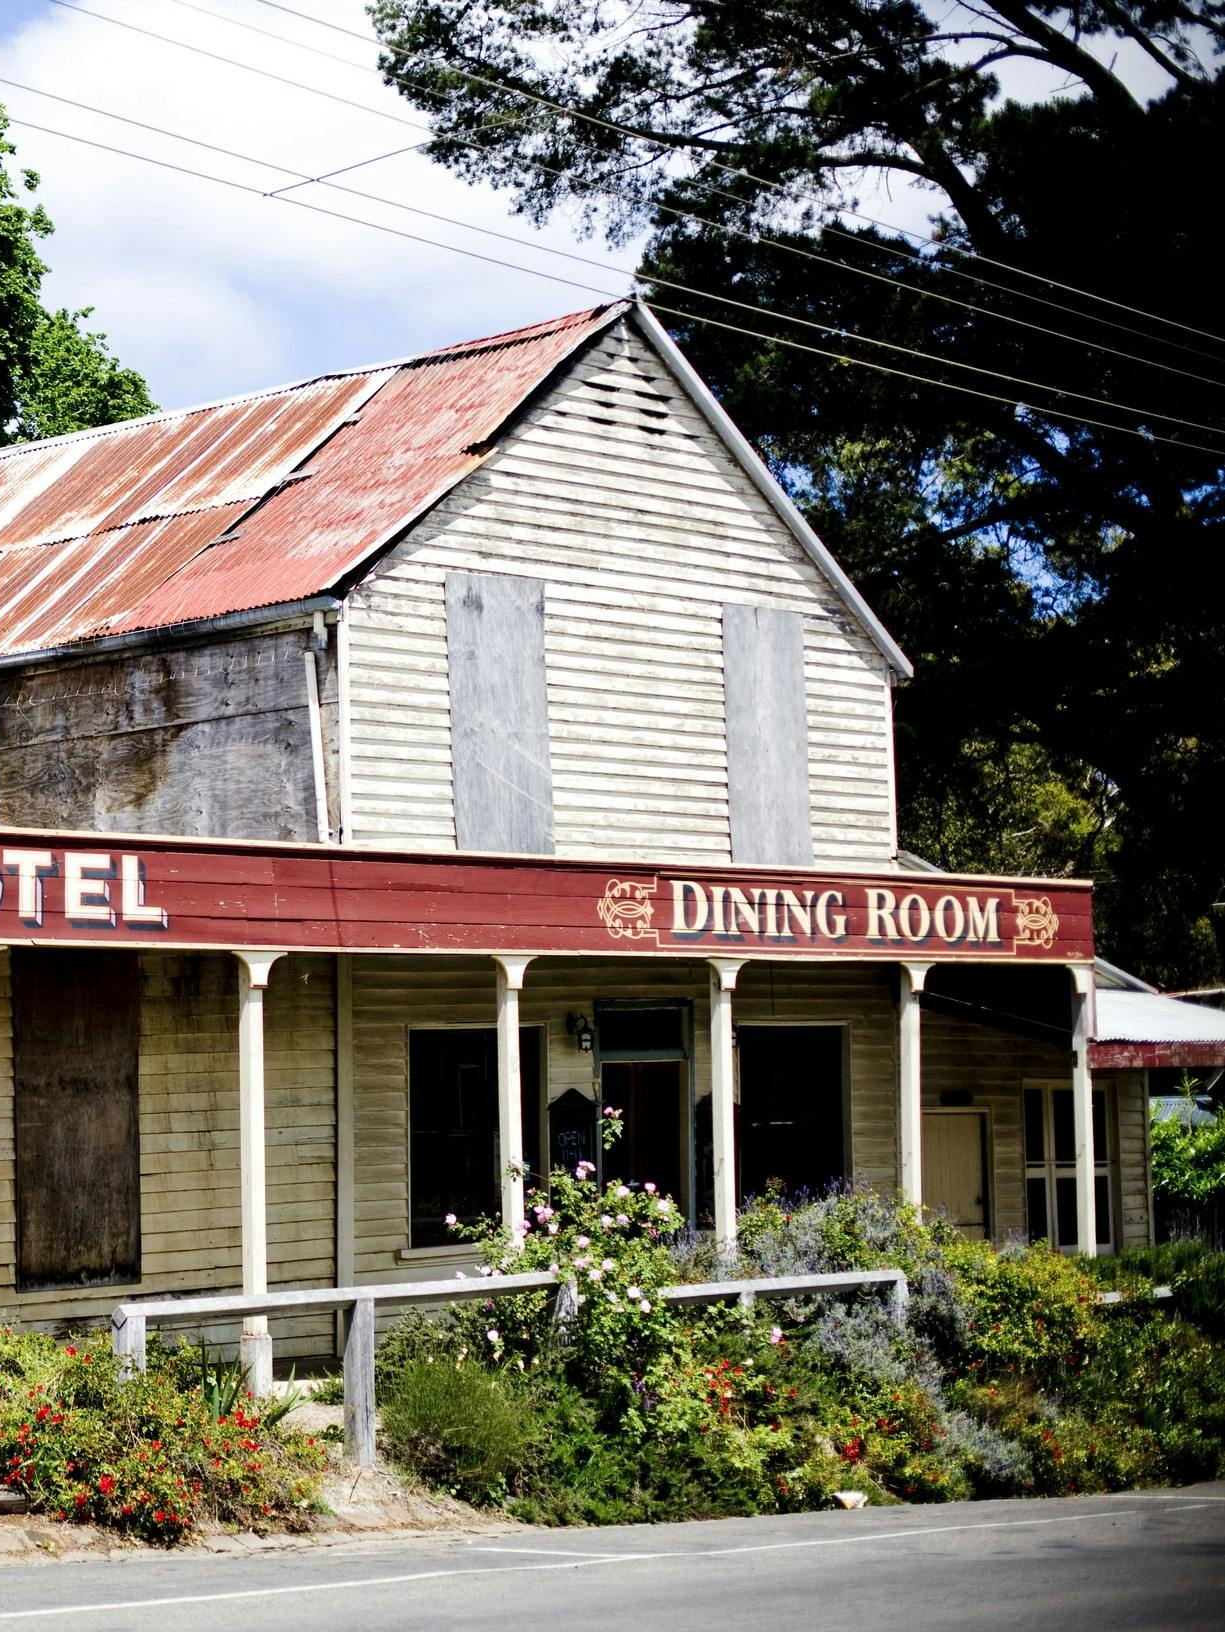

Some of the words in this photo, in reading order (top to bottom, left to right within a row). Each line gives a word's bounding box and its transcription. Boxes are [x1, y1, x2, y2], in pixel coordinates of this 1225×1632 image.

[669, 879, 847, 942] DINING
[864, 888, 1004, 945] ROOM
[558, 1130, 586, 1148] OPEN
